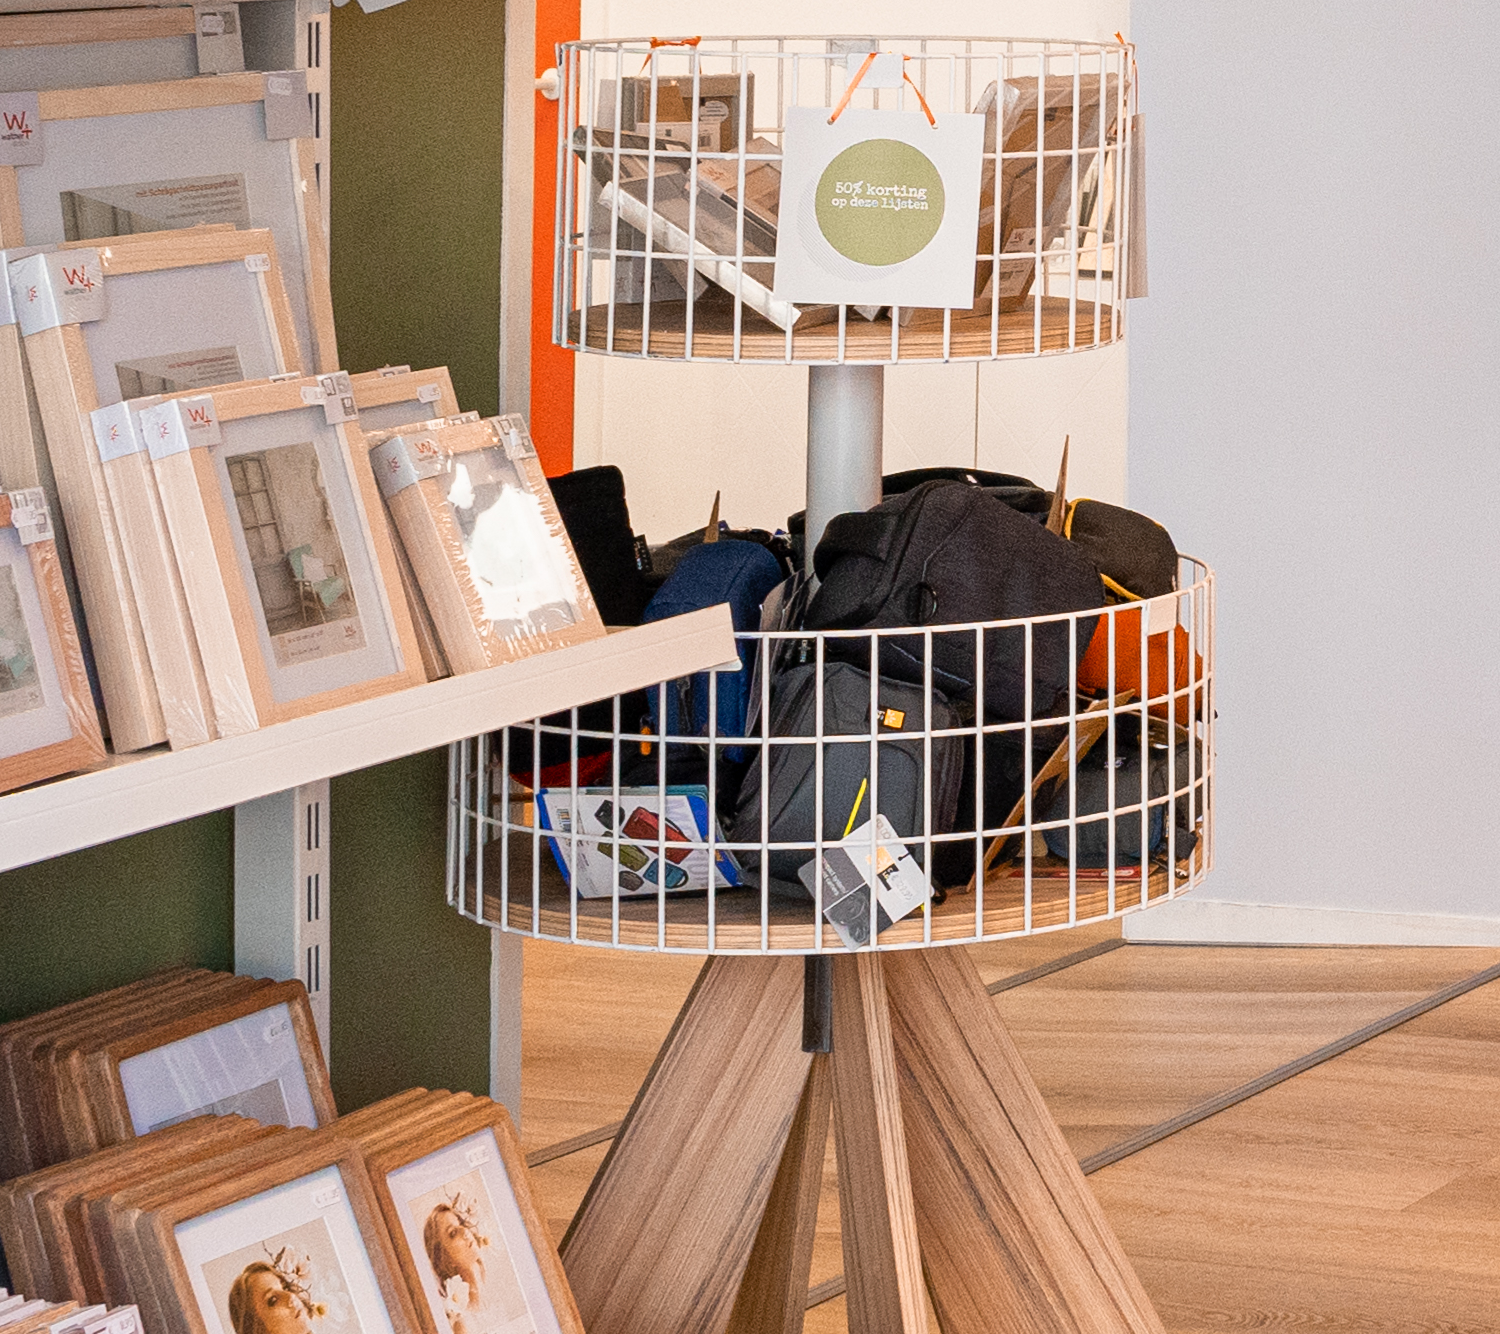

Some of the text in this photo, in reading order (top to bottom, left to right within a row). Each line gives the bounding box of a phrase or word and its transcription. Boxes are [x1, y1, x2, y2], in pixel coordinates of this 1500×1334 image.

[835, 180, 928, 201] 50% korting
[831, 197, 929, 212] op deze lijsten
